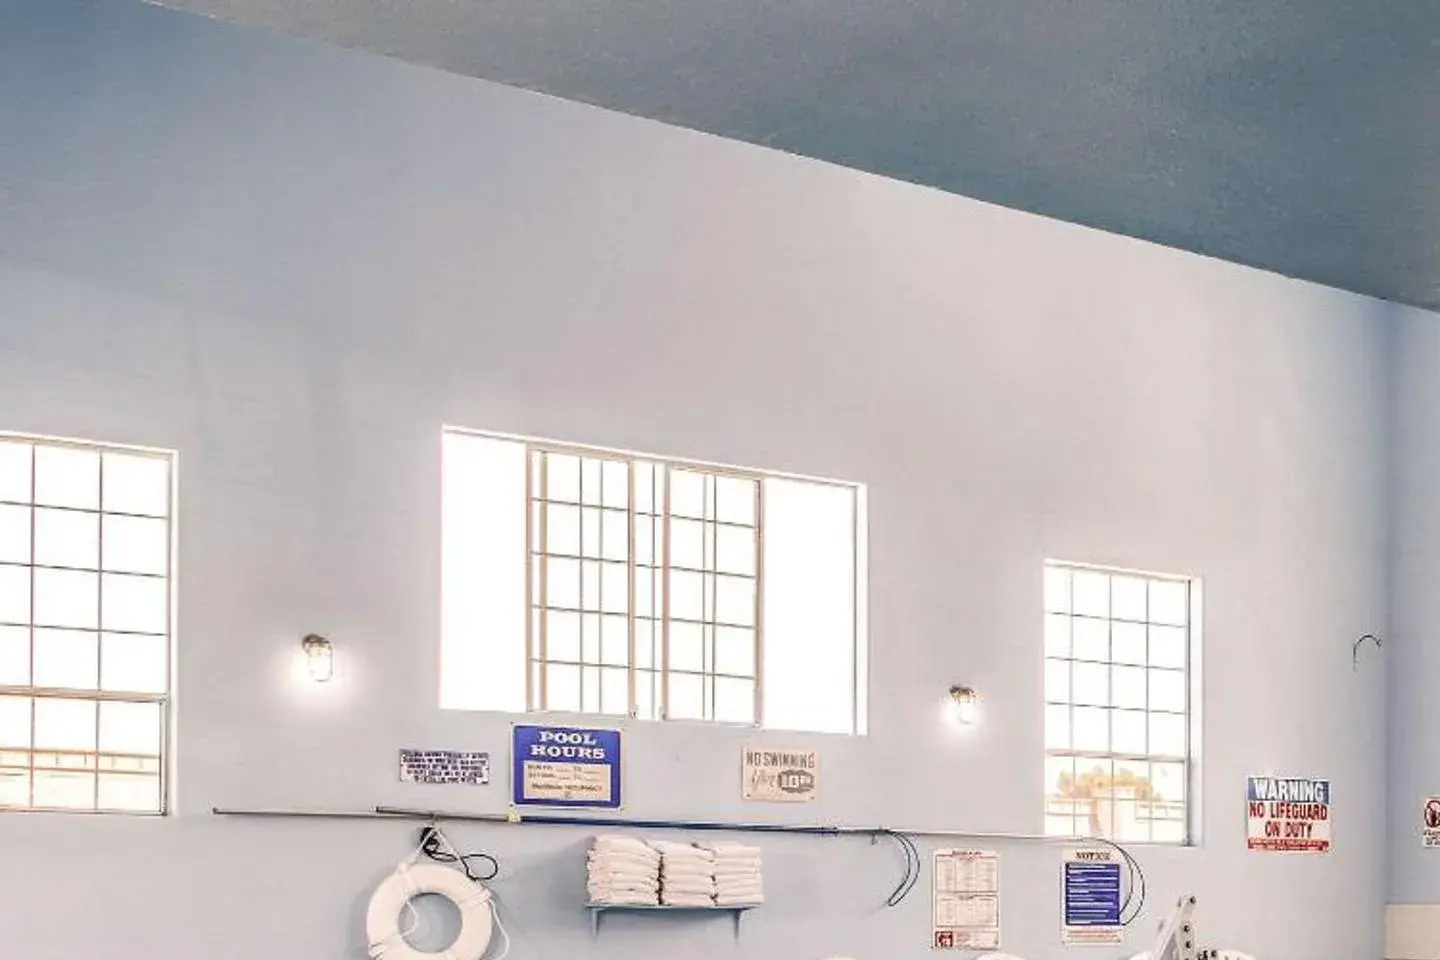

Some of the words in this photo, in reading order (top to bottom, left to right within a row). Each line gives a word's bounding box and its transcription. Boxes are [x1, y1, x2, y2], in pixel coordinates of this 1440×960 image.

[539, 730, 597, 746] POOL
[530, 744, 606, 760] HOURS
[1254, 779, 1325, 802] WARNING
[1249, 801, 1265, 818] NO
[1270, 802, 1328, 821] LIFEGUARD
[1264, 821, 1281, 838] ON
[1284, 822, 1313, 839] DUTY
